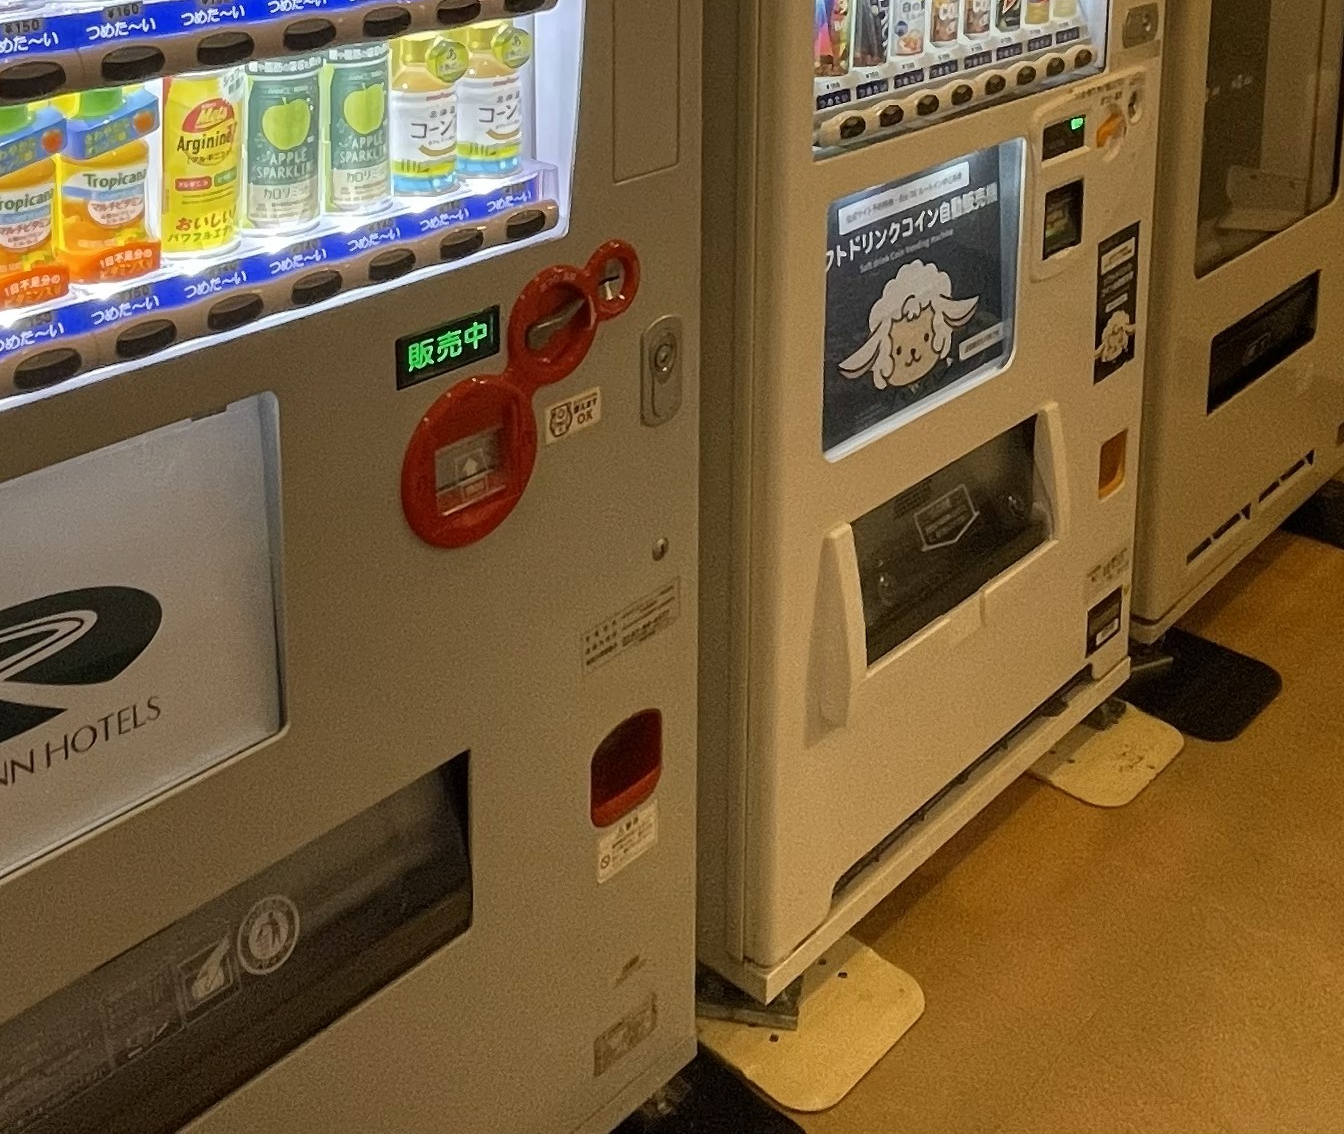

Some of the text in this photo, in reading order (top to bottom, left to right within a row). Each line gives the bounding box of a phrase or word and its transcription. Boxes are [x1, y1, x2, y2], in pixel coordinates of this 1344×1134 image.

[85, 17, 157, 41] つめた〜い
[269, 151, 307, 165] APPLE
[419, 208, 470, 231] つめた〜い
[90, 295, 161, 327] つめた〜い
[407, 321, 488, 373] 販売中
[44, 694, 162, 769] HOTELS
